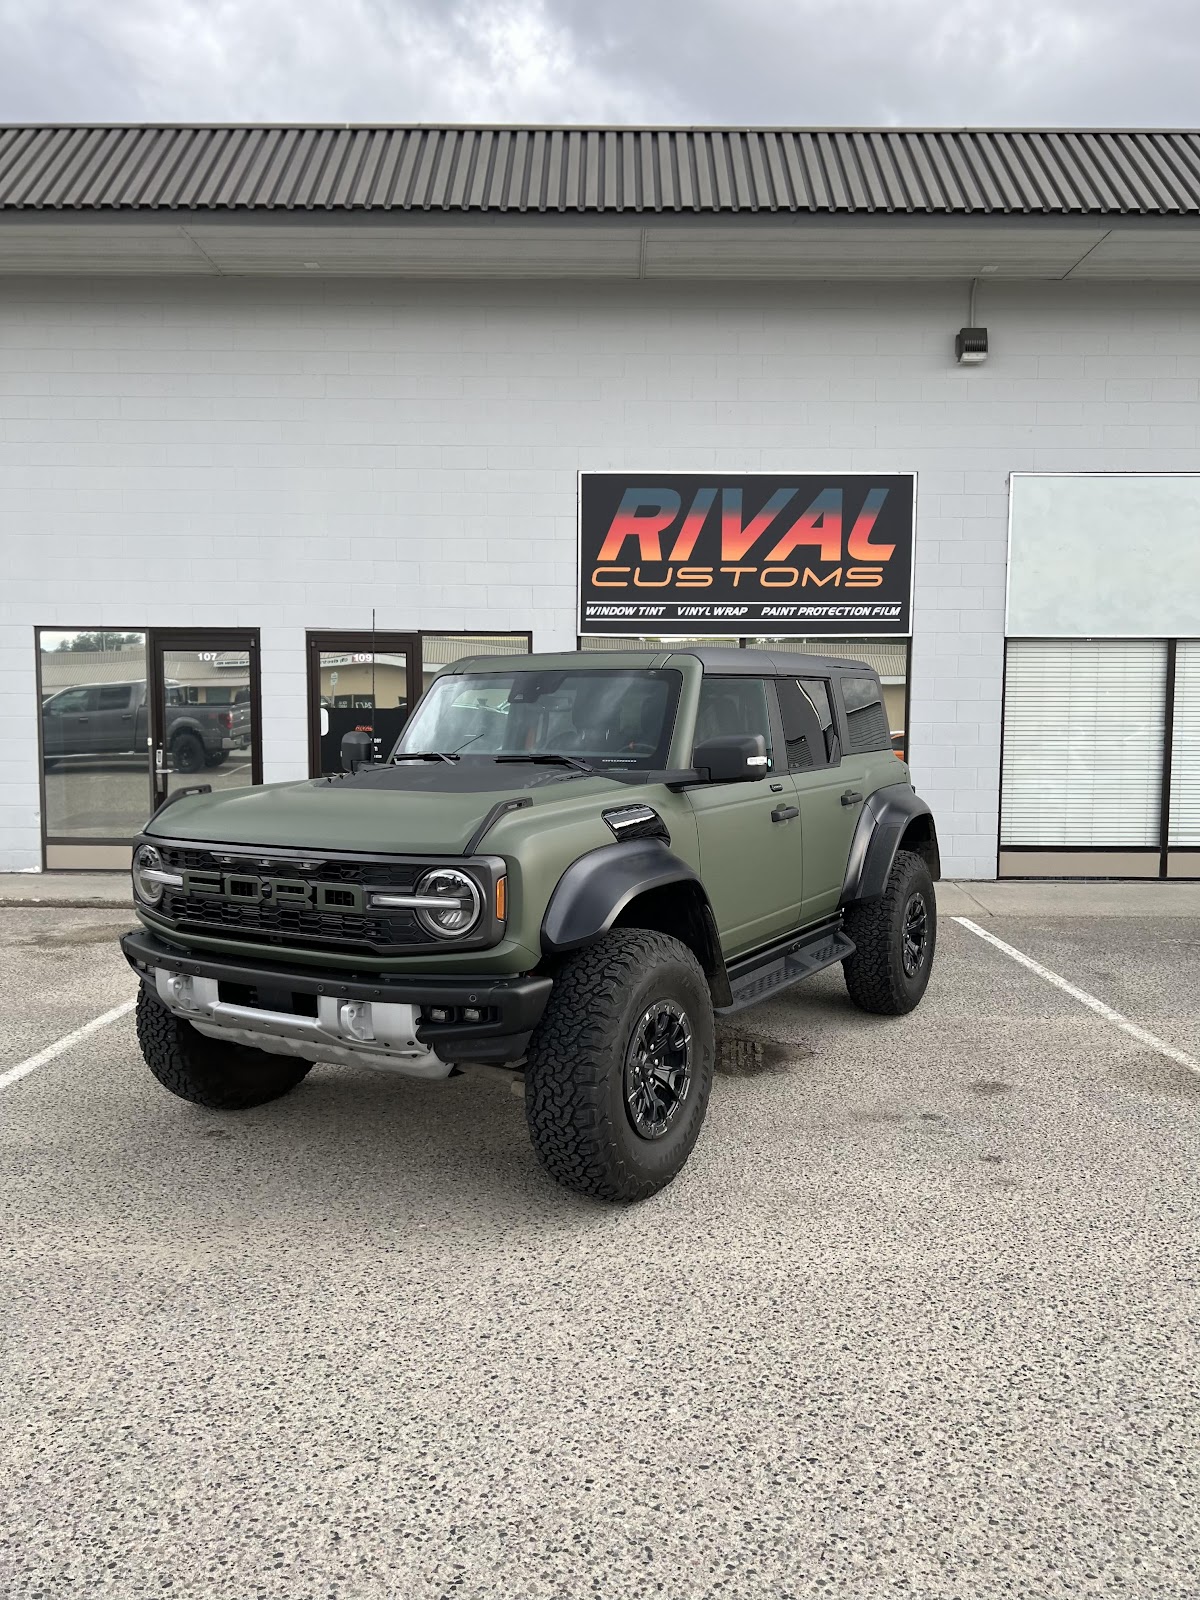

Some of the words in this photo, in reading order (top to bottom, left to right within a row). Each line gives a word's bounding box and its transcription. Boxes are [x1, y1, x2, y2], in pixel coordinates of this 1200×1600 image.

[597, 488, 896, 562] RIVAL
[591, 566, 884, 588] CUSTOMS
[585, 606, 638, 616] WINDOW
[638, 606, 667, 616] TINT
[678, 606, 712, 616] VINYL
[713, 606, 750, 616] WRAP
[760, 606, 798, 616] PAINT
[798, 606, 872, 616] PROTECTION
[872, 606, 902, 616] FILM
[198, 652, 217, 661] 107
[353, 653, 372, 662] 109
[182, 868, 365, 914] FORD
